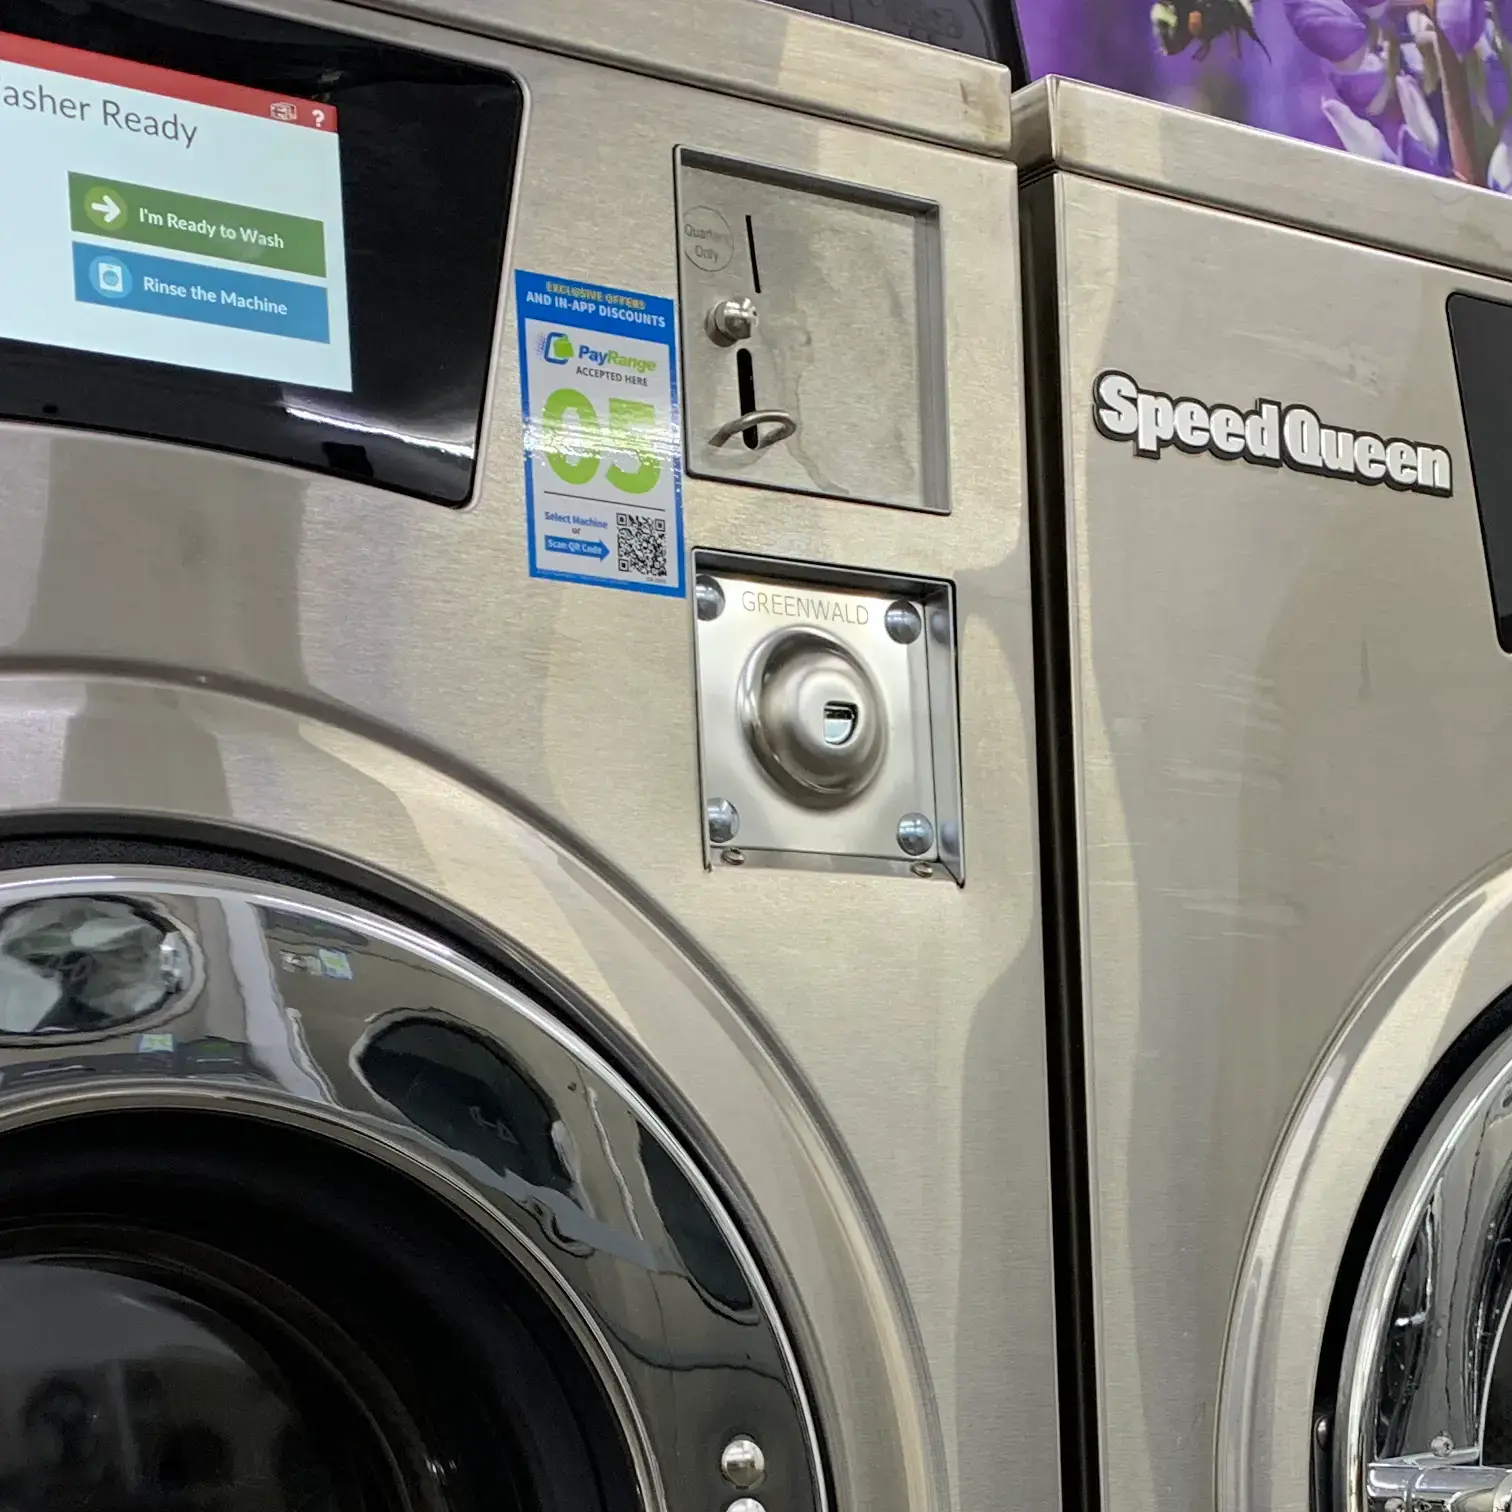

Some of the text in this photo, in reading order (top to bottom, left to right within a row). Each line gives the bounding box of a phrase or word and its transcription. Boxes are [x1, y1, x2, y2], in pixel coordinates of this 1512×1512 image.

[0, 84, 198, 149] asher Ready
[139, 207, 285, 249] I'm Ready to Wash
[143, 276, 289, 316] Rinse the Machine
[526, 291, 666, 328] AND IN-APP DISCOUNTS
[575, 366, 648, 387] ACCEPTED HERE
[578, 344, 657, 373] PayRange
[542, 387, 662, 495] 05
[544, 511, 609, 530] Select Machine
[571, 527, 581, 535] or
[547, 539, 567, 551] Scan
[741, 590, 869, 626] GREENWALD
